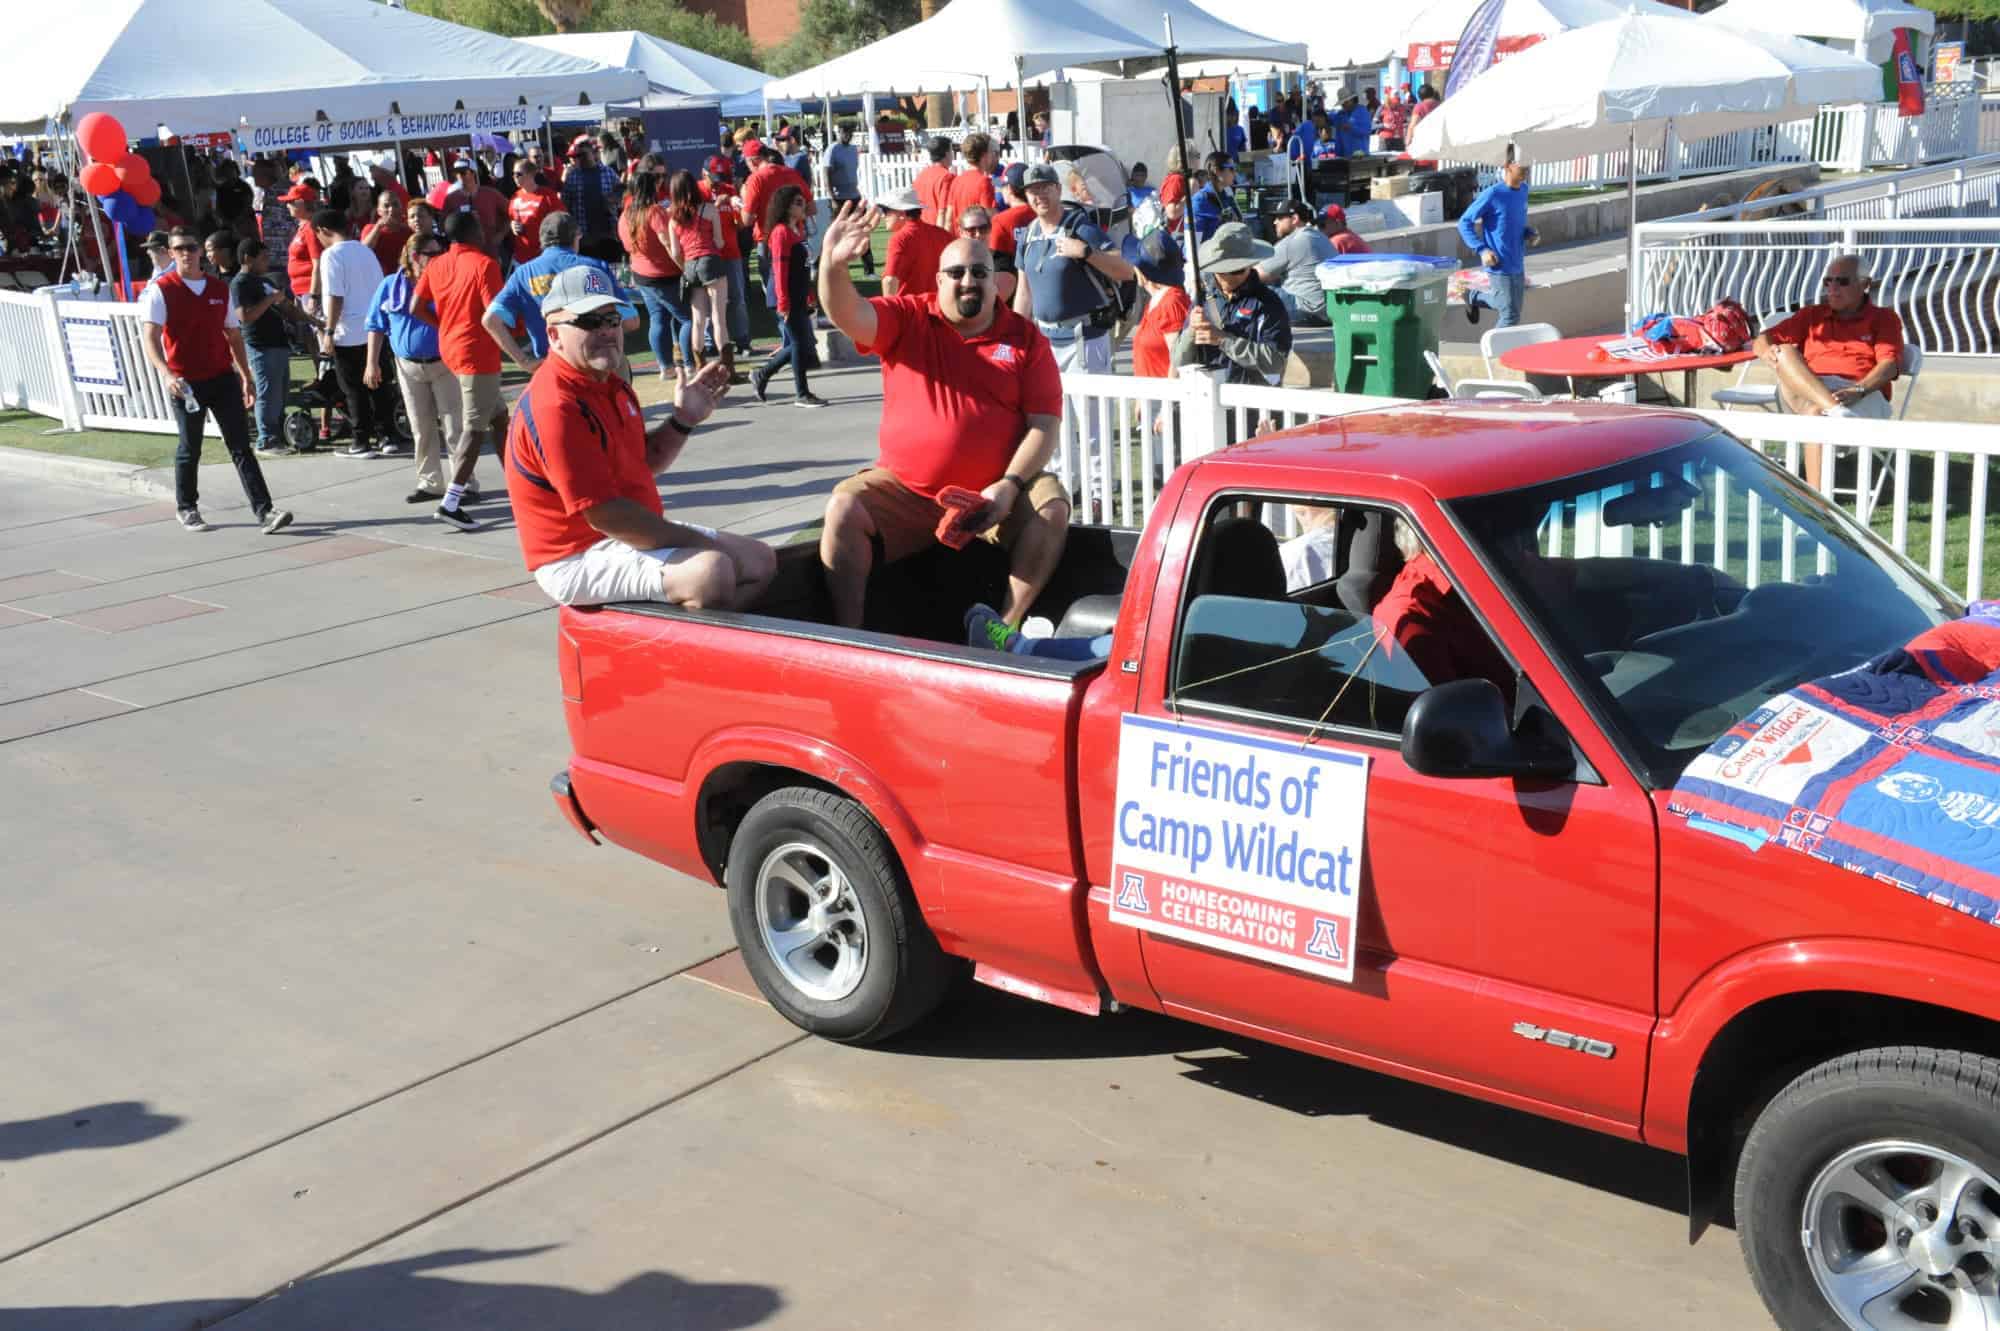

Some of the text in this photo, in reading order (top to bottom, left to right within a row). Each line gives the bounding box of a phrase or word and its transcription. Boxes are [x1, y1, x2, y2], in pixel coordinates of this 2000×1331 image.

[254, 108, 527, 147] COLLEGE OF SOCIAL & BEHAVIORAL SCIENCES
[1722, 745, 1767, 778] Camp
[1755, 706, 1812, 745] Wildcat
[1151, 741, 1320, 818] Friends of
[1119, 801, 1353, 895] Camp Wildcat
[1161, 880, 1296, 929] HOMECOMING
[1161, 901, 1295, 950] CELEBRATION
